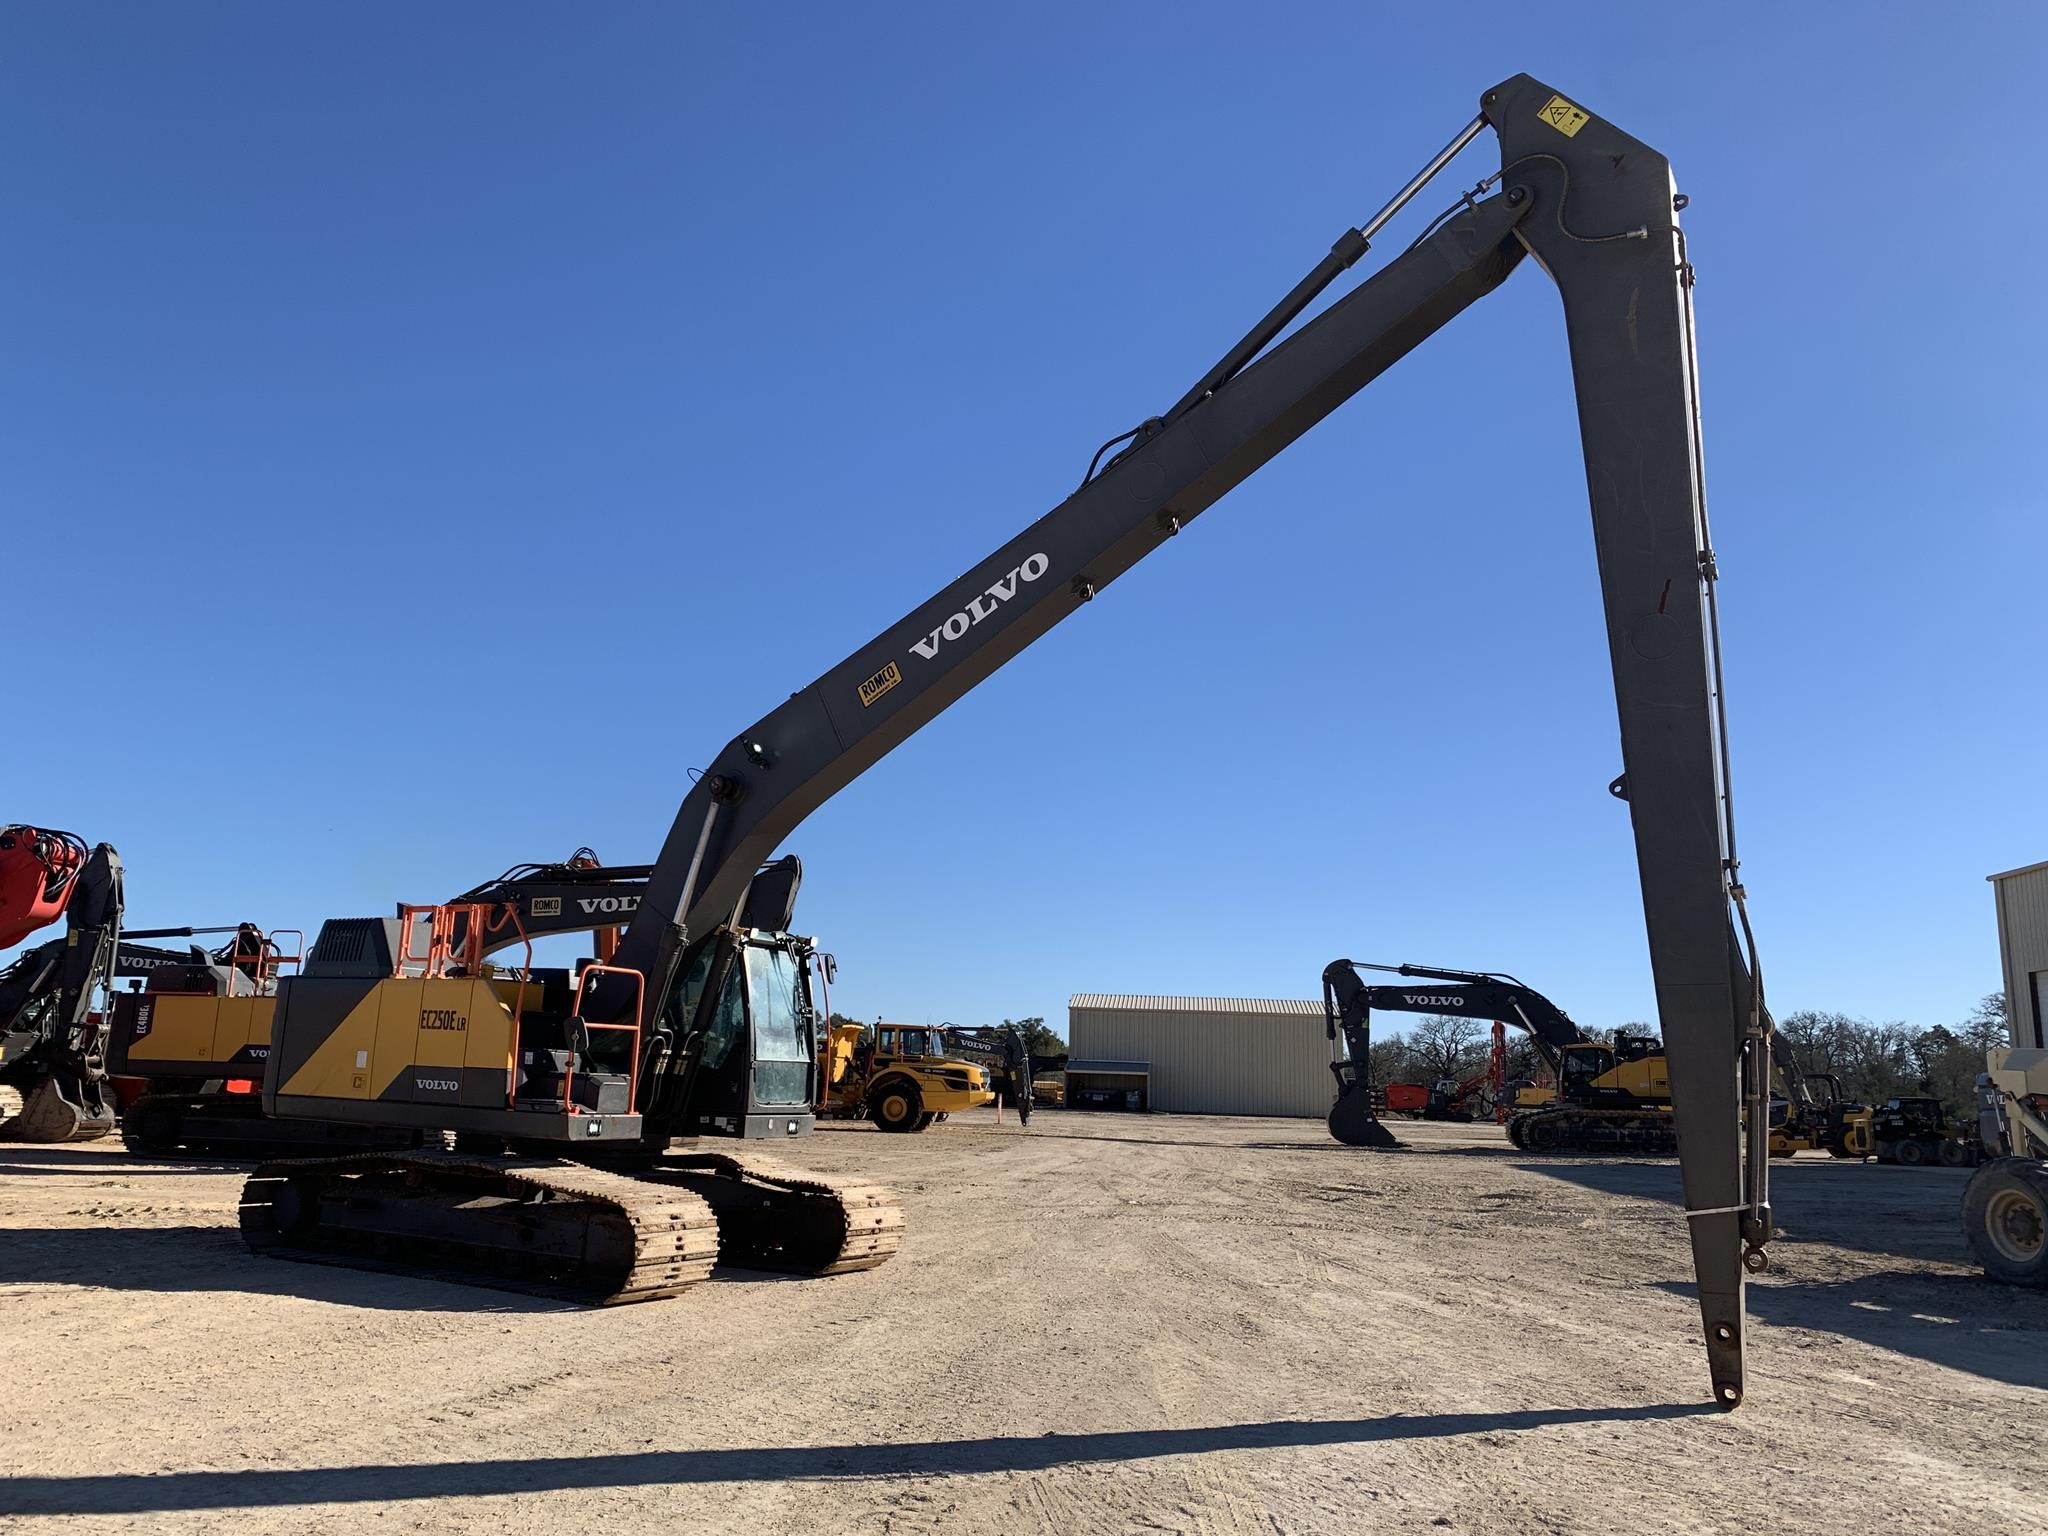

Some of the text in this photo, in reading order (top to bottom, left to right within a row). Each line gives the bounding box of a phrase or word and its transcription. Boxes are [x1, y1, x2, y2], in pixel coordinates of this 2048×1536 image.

[908, 552, 1049, 660] VOLVO
[861, 665, 896, 699] ROMCO
[533, 898, 560, 911] ROMCO
[1402, 995, 1464, 1007] VOLVO
[420, 1009, 467, 1031] EC250E LR
[960, 1039, 992, 1051] VOLVO
[416, 1079, 459, 1091] VOLVO
